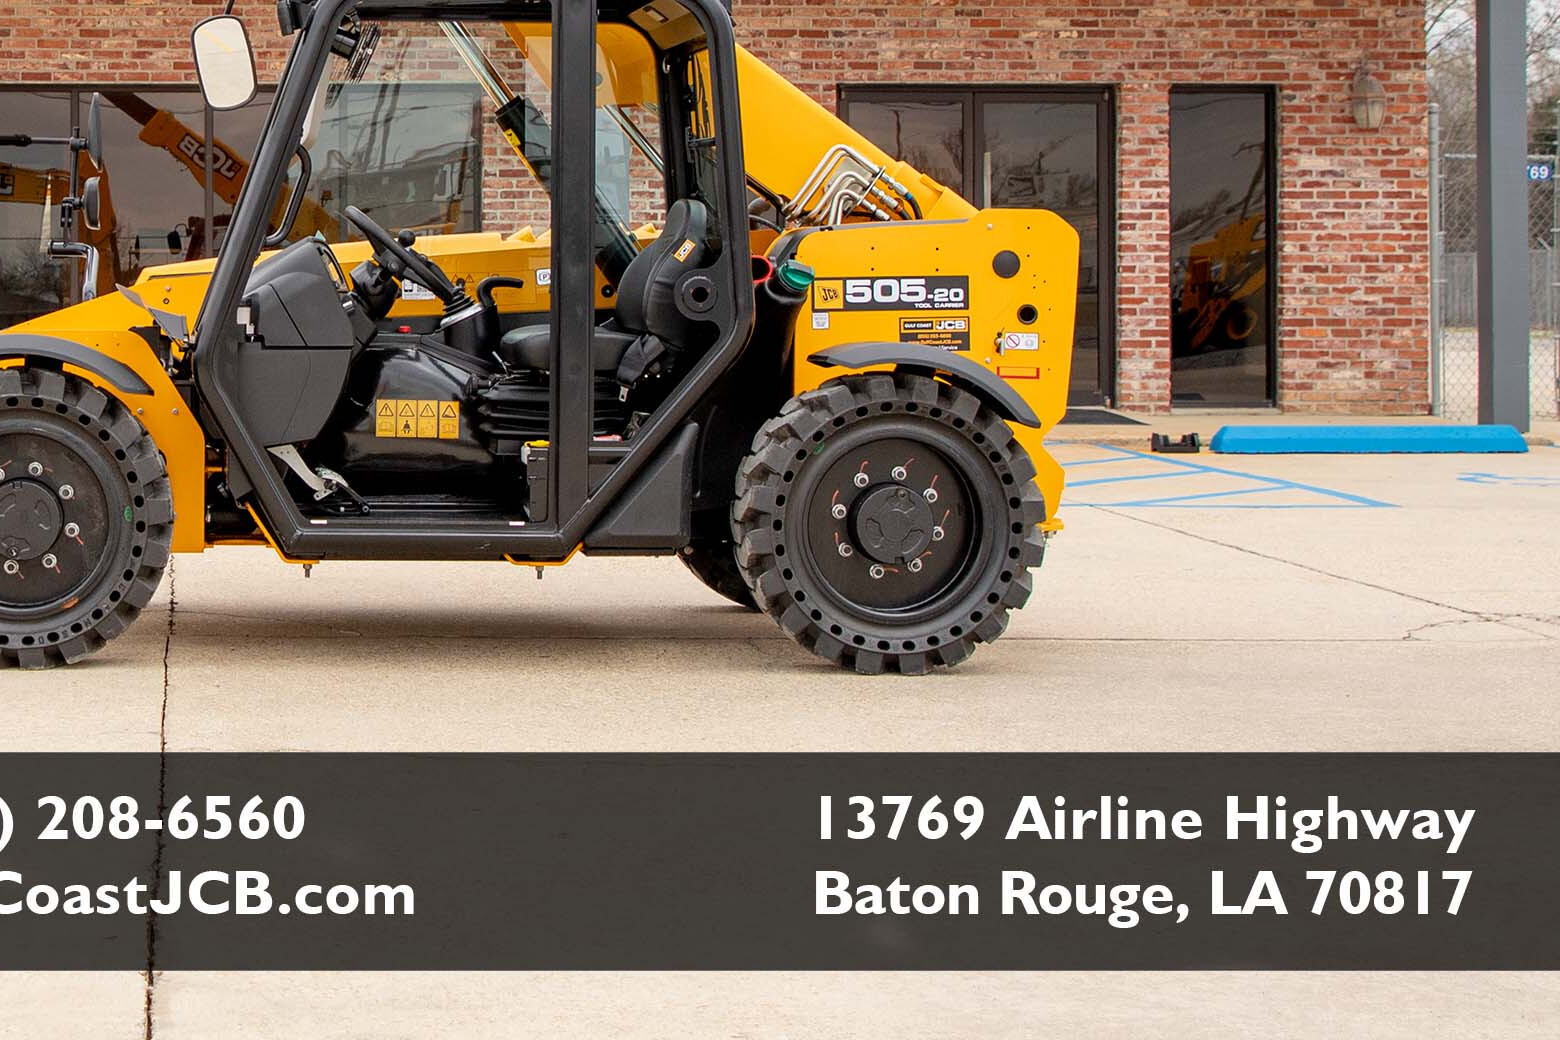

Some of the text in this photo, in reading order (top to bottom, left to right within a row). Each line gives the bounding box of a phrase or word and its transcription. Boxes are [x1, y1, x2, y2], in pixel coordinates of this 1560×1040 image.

[1527, 165, 1548, 179] 69
[822, 288, 838, 301] JCB
[845, 278, 964, 303] 505-20
[936, 320, 965, 330] JCB
